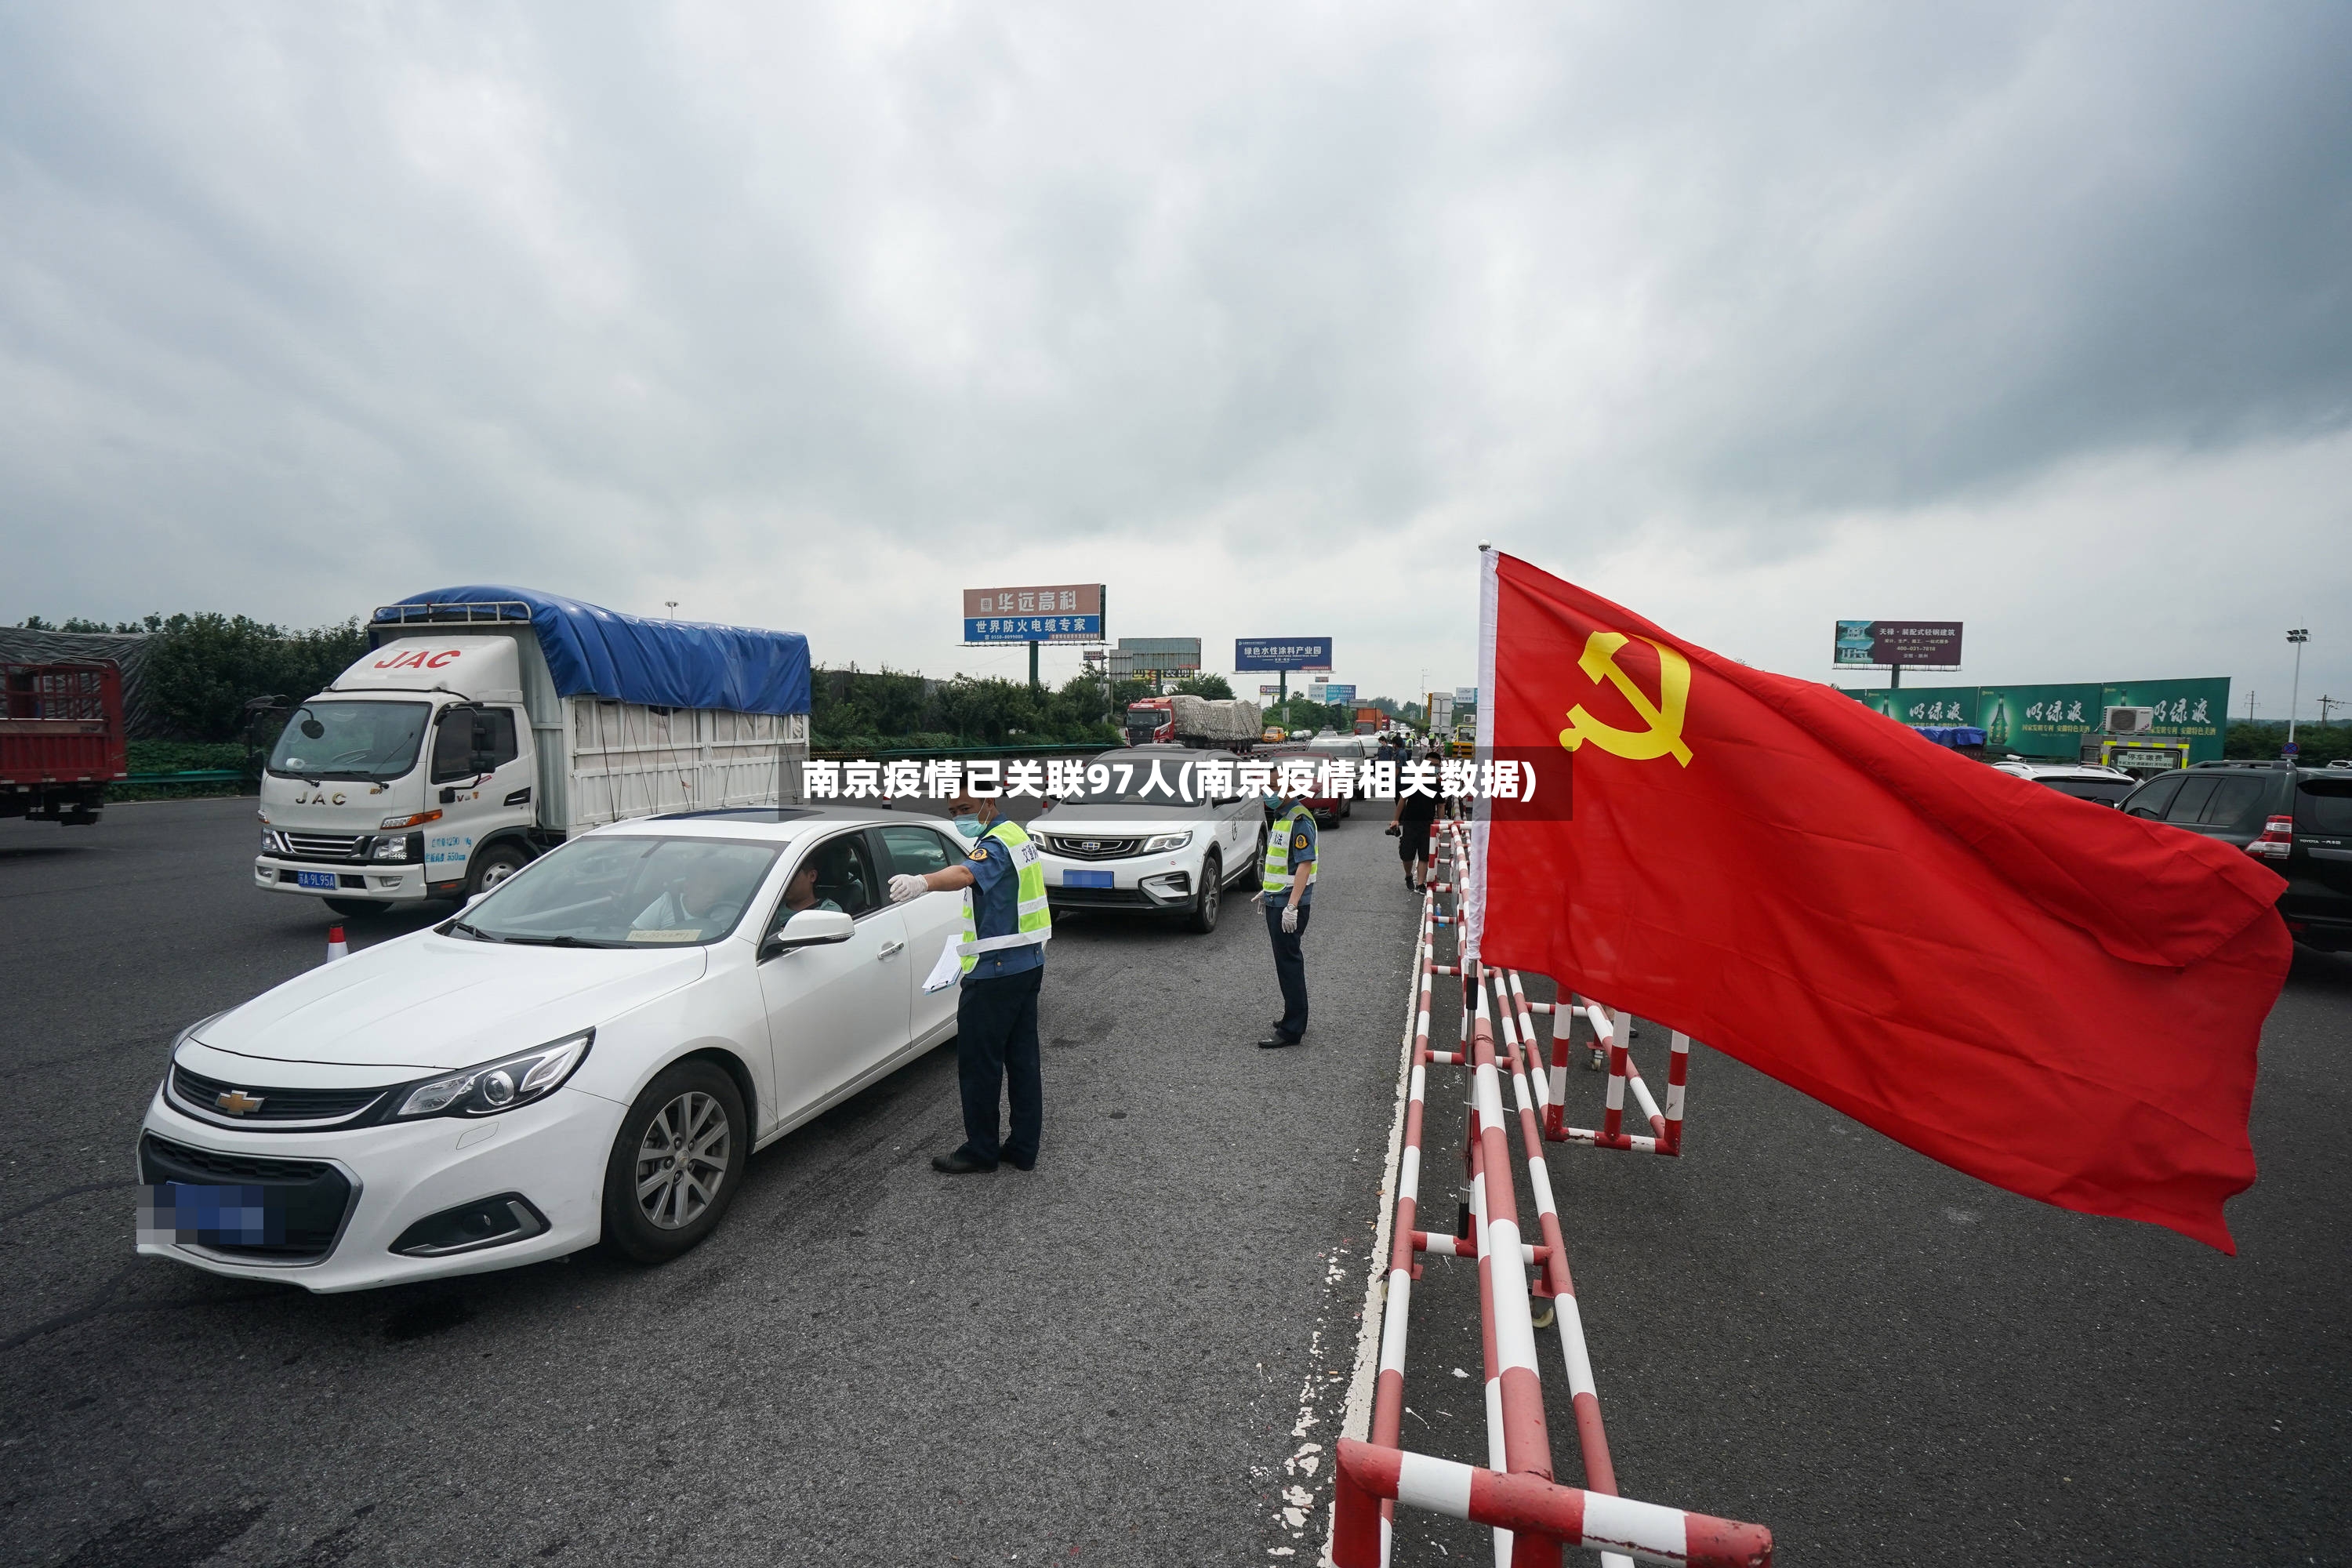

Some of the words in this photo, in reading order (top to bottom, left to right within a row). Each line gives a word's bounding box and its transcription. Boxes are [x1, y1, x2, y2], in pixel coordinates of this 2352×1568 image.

[998, 590, 1076, 612] 华远高科
[976, 617, 1085, 633] 世界防火电缆专家
[1244, 646, 1322, 655] 绿色水性涂料产业园
[374, 650, 461, 668] JAC
[296, 791, 347, 806] JAC
